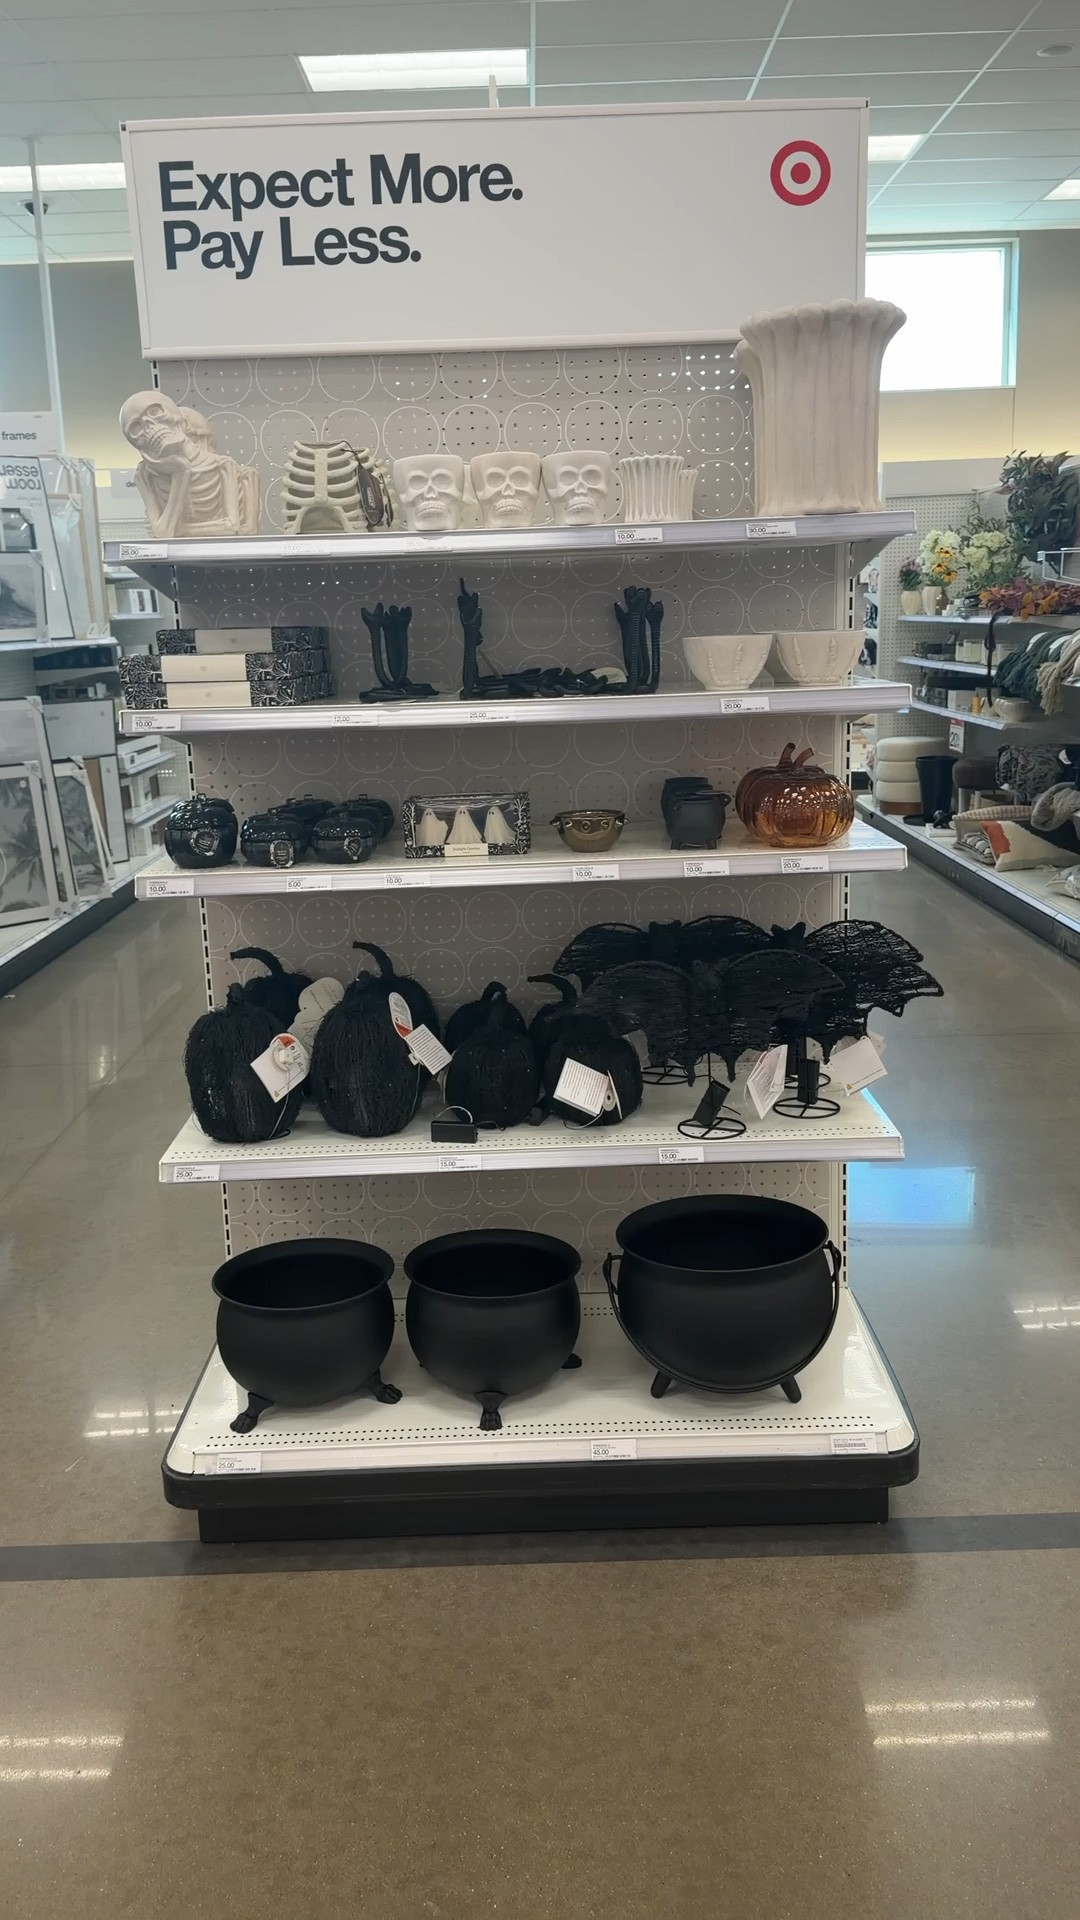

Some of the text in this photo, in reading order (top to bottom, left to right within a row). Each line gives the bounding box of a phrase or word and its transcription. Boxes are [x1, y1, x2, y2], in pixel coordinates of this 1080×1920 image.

[158, 153, 523, 221] Expect More.
[163, 216, 421, 280] Pay Less.
[2, 431, 37, 440] frames
[592, 1448, 610, 1456] 45.00
